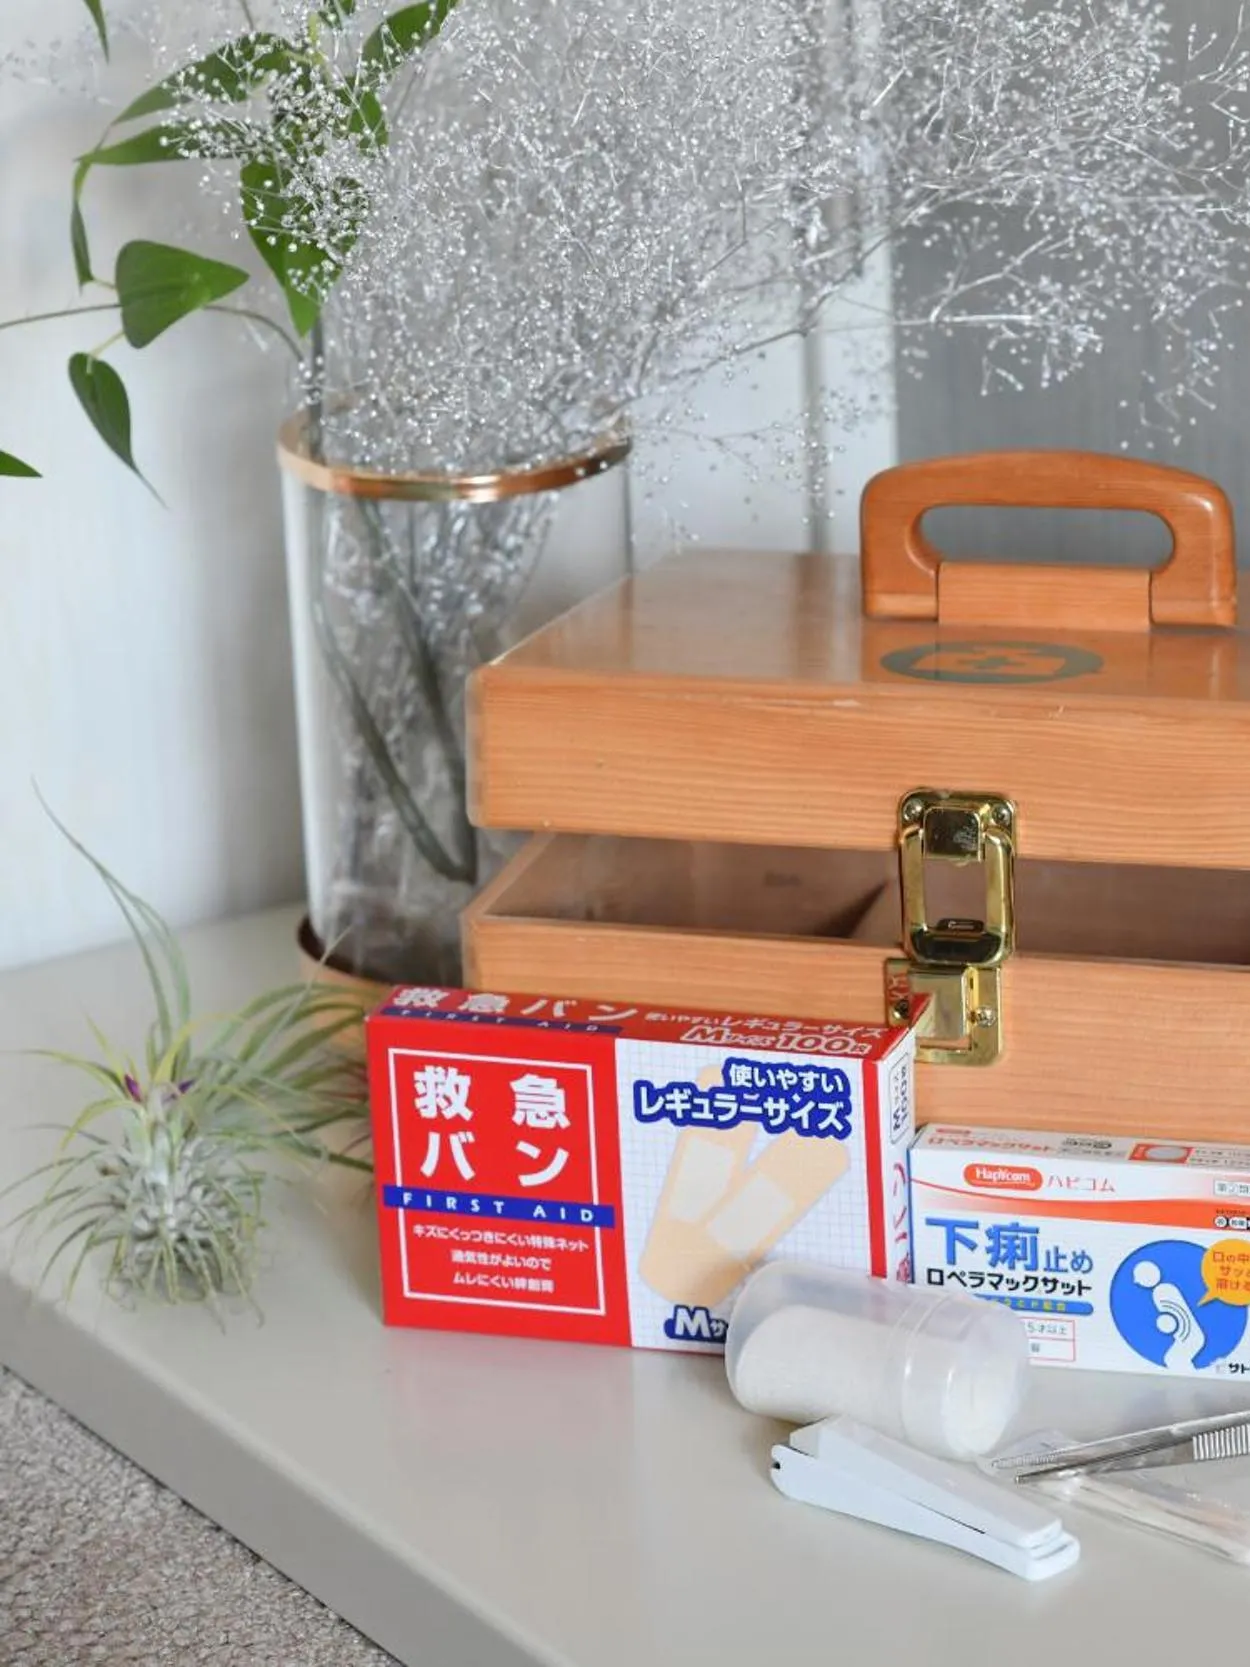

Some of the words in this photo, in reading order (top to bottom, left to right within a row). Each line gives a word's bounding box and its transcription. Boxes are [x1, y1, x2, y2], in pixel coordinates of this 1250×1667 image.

[729, 1063, 844, 1093] 使いやすい
[412, 1065, 571, 1131] 救急
[639, 1086, 845, 1132] レギュラーサイズ
[419, 1131, 571, 1188] バン
[1047, 1174, 1116, 1192] ハピコム
[402, 1192, 505, 1214] FIRST
[532, 1204, 594, 1223] AID
[925, 1216, 1094, 1275] 下痢止め
[926, 1267, 1093, 1297] ロペラマックサット
